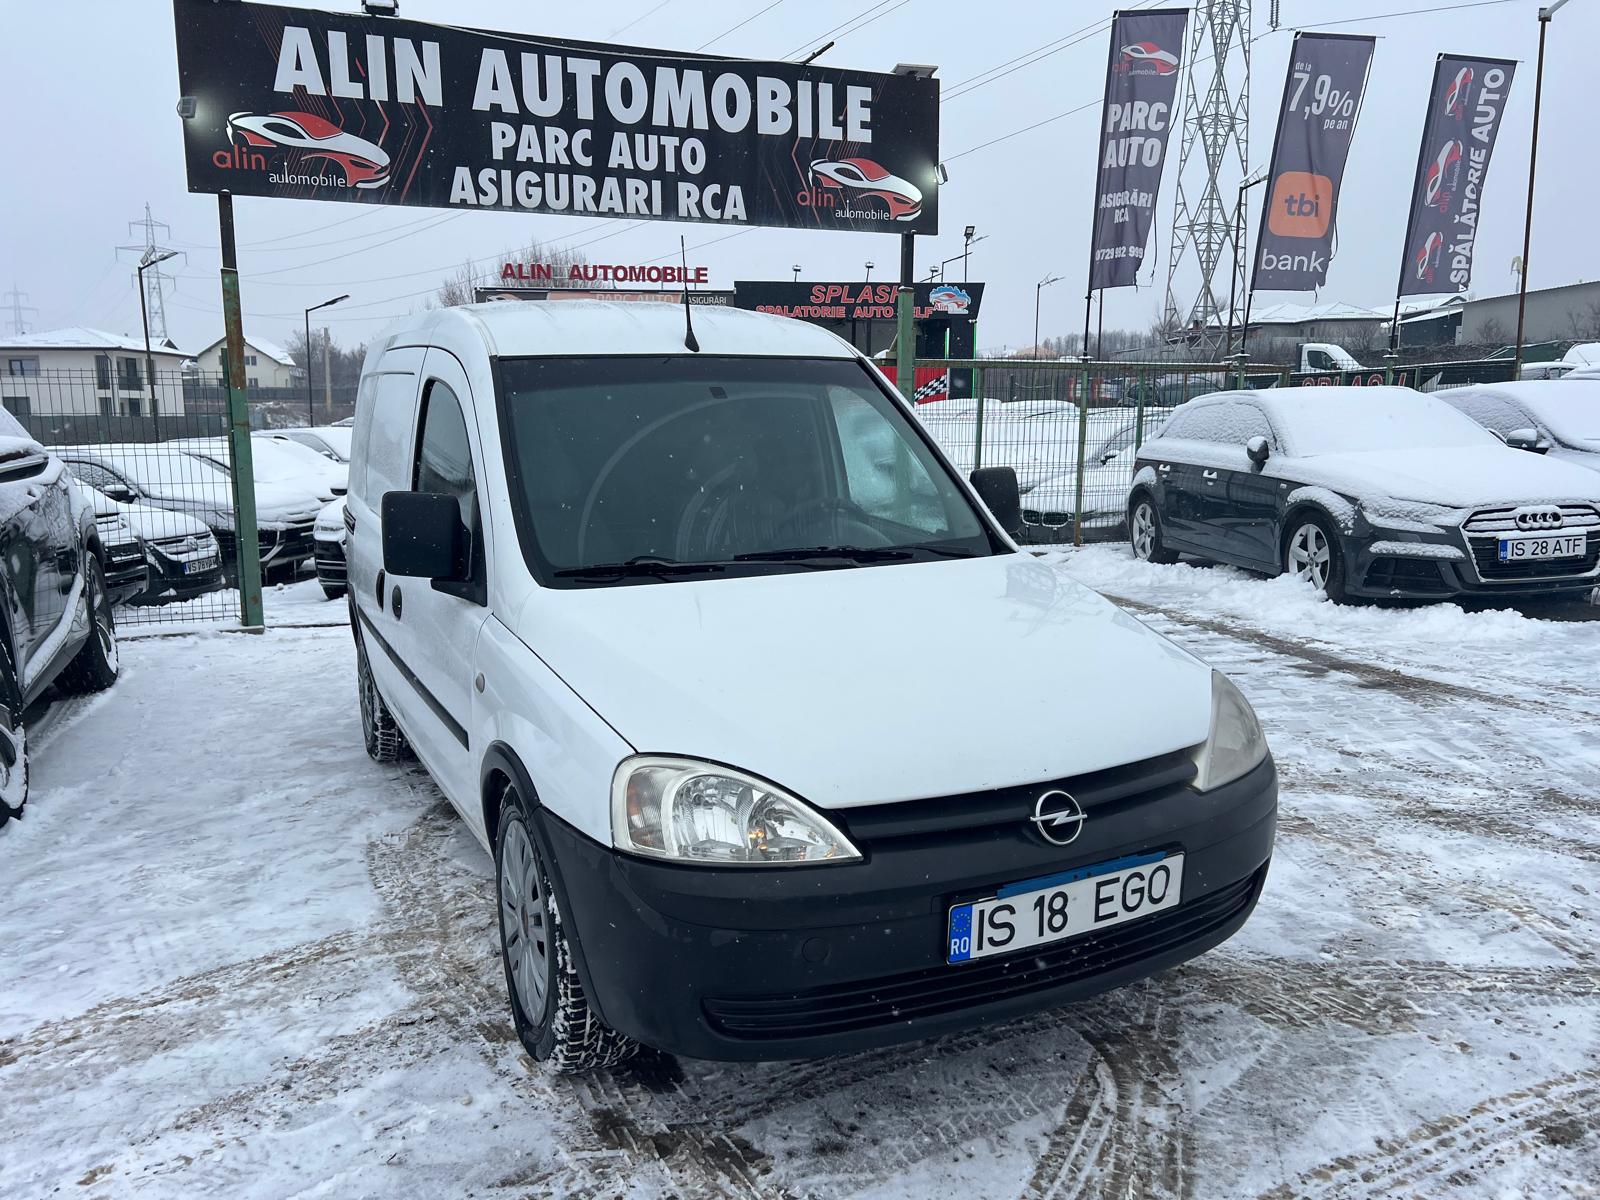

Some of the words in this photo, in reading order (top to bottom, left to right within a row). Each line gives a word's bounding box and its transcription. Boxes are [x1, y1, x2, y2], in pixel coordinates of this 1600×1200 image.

[1296, 62, 1304, 71] de
[1305, 62, 1312, 72] la
[273, 25, 443, 107] ALIN
[472, 47, 872, 143] AUTOMOBILE
[1289, 72, 1354, 120] 7,9%
[1106, 102, 1168, 133] PARC
[1323, 118, 1336, 130] pe
[1336, 119, 1348, 130] an
[212, 144, 266, 171] alin
[491, 121, 592, 167] PARC
[607, 131, 707, 175] AUTO
[1103, 137, 1162, 169] AUTO
[1448, 147, 1487, 284] SPĂLĂTORIE
[1471, 68, 1506, 144] AUTO
[449, 166, 662, 216] ASIGURARI
[677, 181, 748, 221] RCA
[797, 185, 836, 208] alin
[1284, 192, 1320, 218] tbi
[1114, 208, 1129, 224] RCA
[501, 263, 551, 280] ALIN
[568, 264, 709, 284] AUTOMOBILE
[1261, 248, 1325, 273] bank
[853, 306, 894, 318] AUTO
[1511, 542, 1525, 557] IS
[1531, 540, 1548, 556] 28
[1552, 538, 1583, 555] ATF
[976, 903, 1016, 951] IS
[1033, 890, 1069, 938] 18
[1093, 864, 1171, 923] EGO
[950, 936, 970, 956] RO
